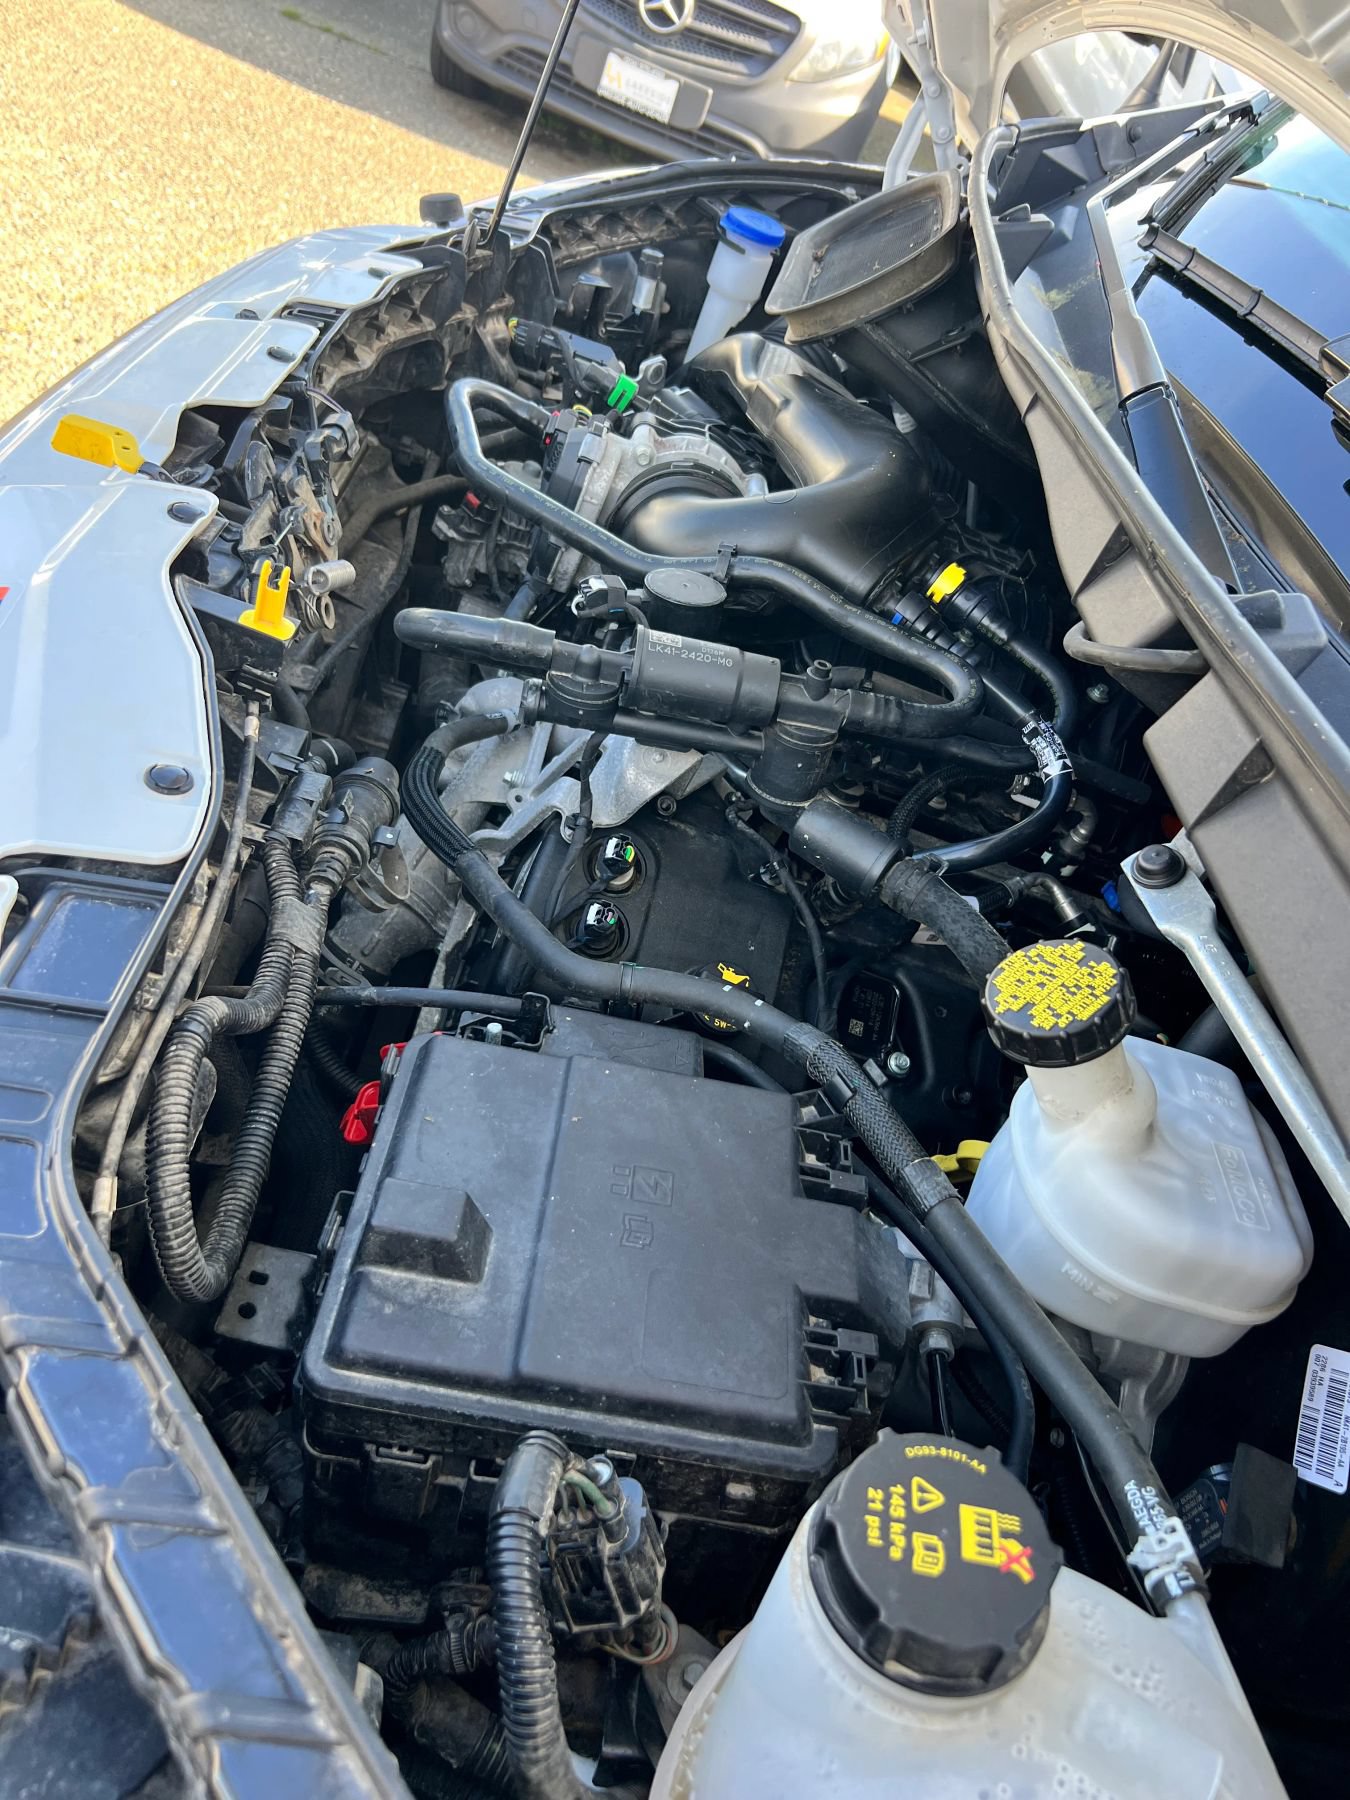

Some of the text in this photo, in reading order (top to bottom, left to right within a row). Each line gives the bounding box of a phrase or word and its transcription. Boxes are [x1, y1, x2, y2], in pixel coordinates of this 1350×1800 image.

[1063, 967, 1092, 989] SEALED
[1089, 966, 1116, 990] BEFORE
[1090, 962, 1111, 977] ONLY
[1076, 974, 1094, 988] DOT
[1049, 991, 1073, 1011] FLUID
[1054, 977, 1116, 1028] CLEAN FILLER CAP
[1032, 1007, 1052, 1026] FROM
[1039, 1015, 1059, 1030] USE
[905, 1446, 987, 1475] DG93-8101-AA
[864, 1487, 884, 1547] 21 psi
[889, 1484, 906, 1561] 145 kPa
